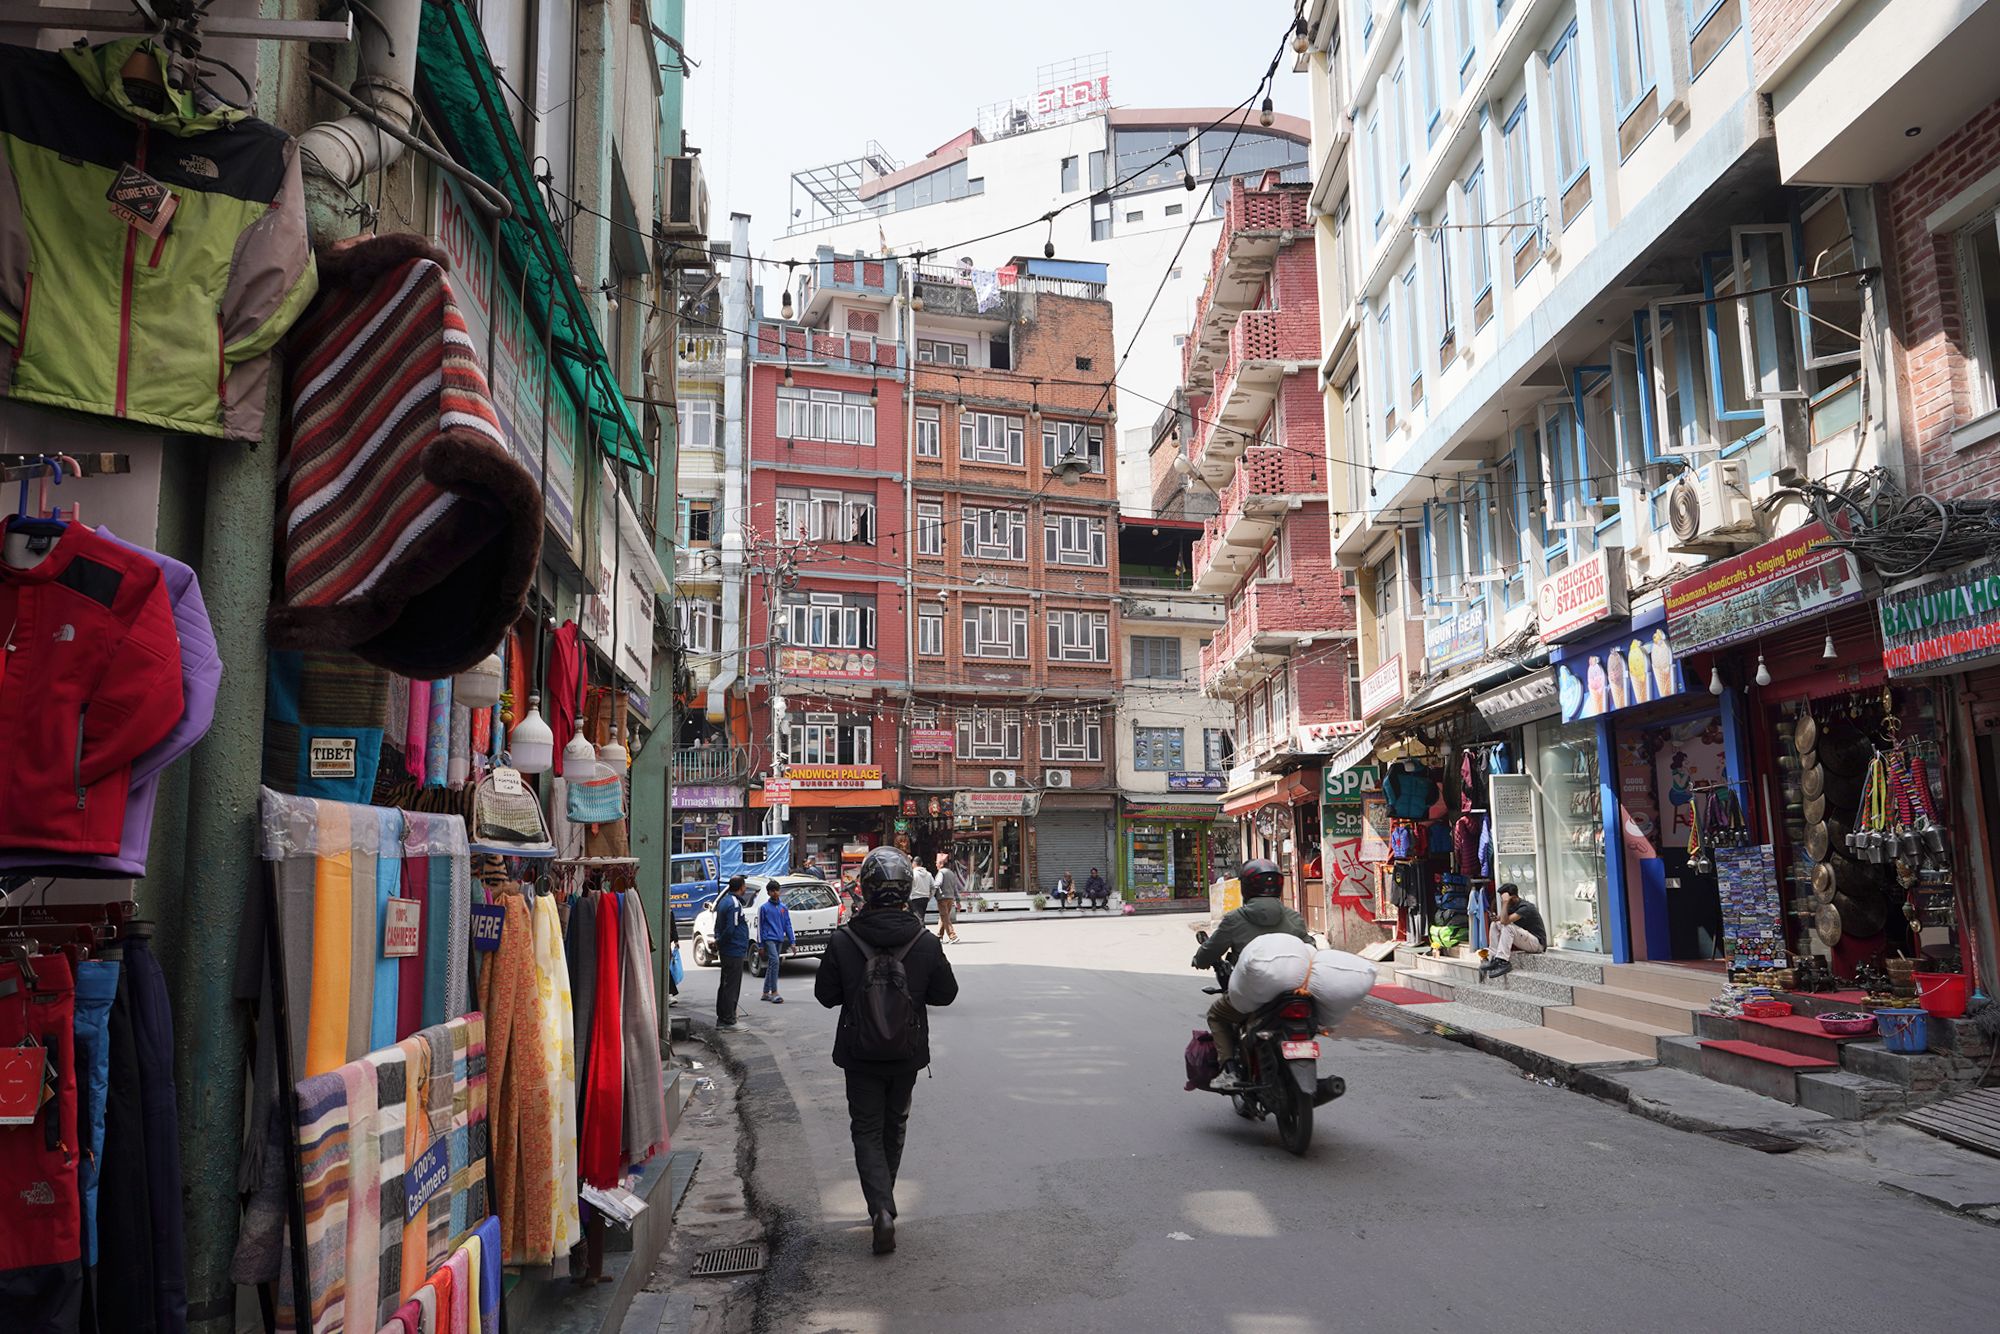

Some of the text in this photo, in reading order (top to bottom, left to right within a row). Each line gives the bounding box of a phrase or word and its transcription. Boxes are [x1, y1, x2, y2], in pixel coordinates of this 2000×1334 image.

[116, 185, 160, 200] GORE-TEX
[111, 205, 137, 223] XCR
[440, 179, 489, 316] ROYAL
[1821, 547, 1839, 560] goods
[1557, 558, 1599, 594] CHICKEN
[1666, 586, 1707, 609] Manakamana
[1707, 569, 1748, 593] Handicrafts
[1748, 564, 1756, 577] &
[1756, 554, 1786, 573] Singing
[1786, 541, 1807, 562] Bowl
[1557, 575, 1604, 615] STATION
[1882, 585, 1972, 636] BATUWA
[1427, 606, 1483, 649] MOUNT GEAR
[313, 747, 353, 760] TIBET
[785, 768, 880, 780] SANDWICH PALACE
[1327, 770, 1376, 795] SPA
[1625, 777, 1644, 785] GOOD
[681, 797, 709, 807] Image
[710, 796, 735, 806] World
[395, 907, 408, 922] 100%
[386, 926, 417, 946] CASHMERE
[414, 1149, 436, 1183] 100%
[408, 1164, 447, 1217] Cashmere
